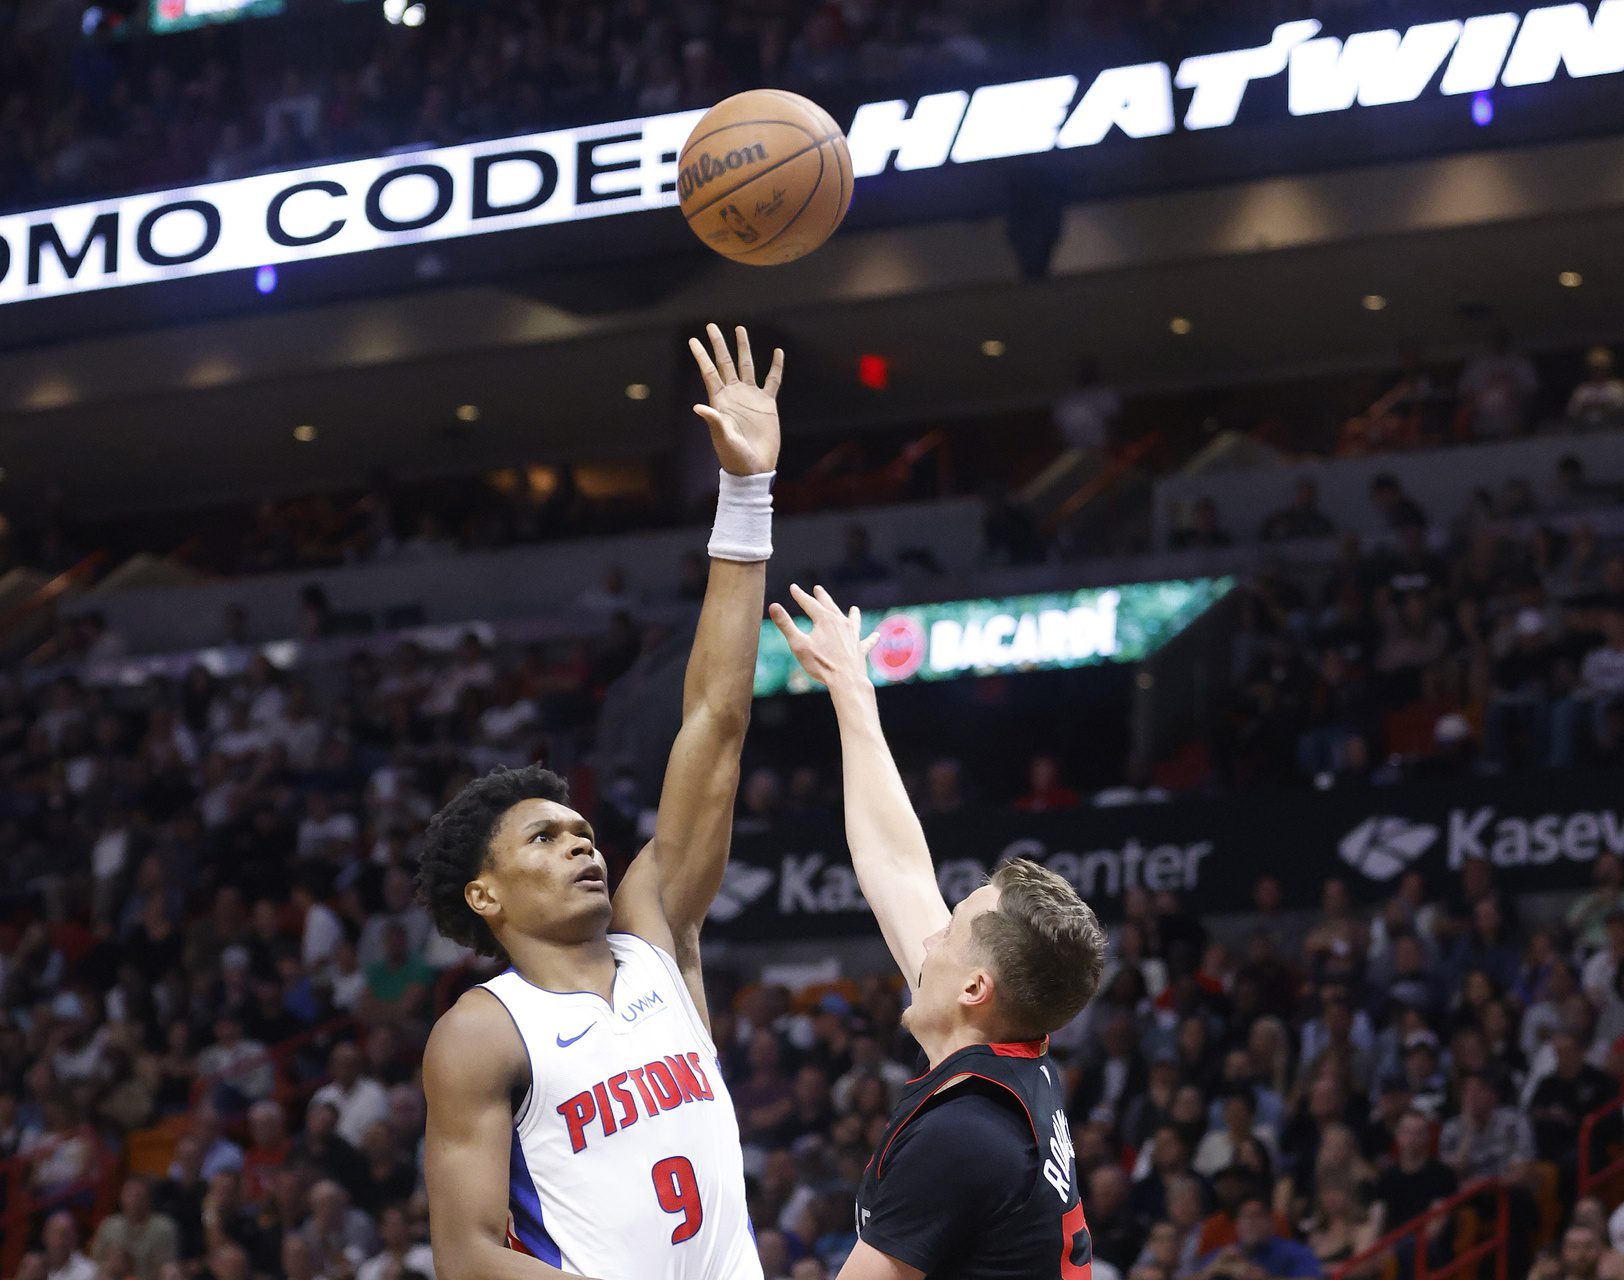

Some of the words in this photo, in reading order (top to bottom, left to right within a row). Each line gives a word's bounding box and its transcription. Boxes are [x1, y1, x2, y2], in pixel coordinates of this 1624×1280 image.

[0, 200, 221, 286] MO
[266, 132, 677, 247] CODE:
[620, 989, 664, 1023] UWM
[556, 1051, 715, 1155] PISTONS
[651, 1155, 703, 1246] 9
